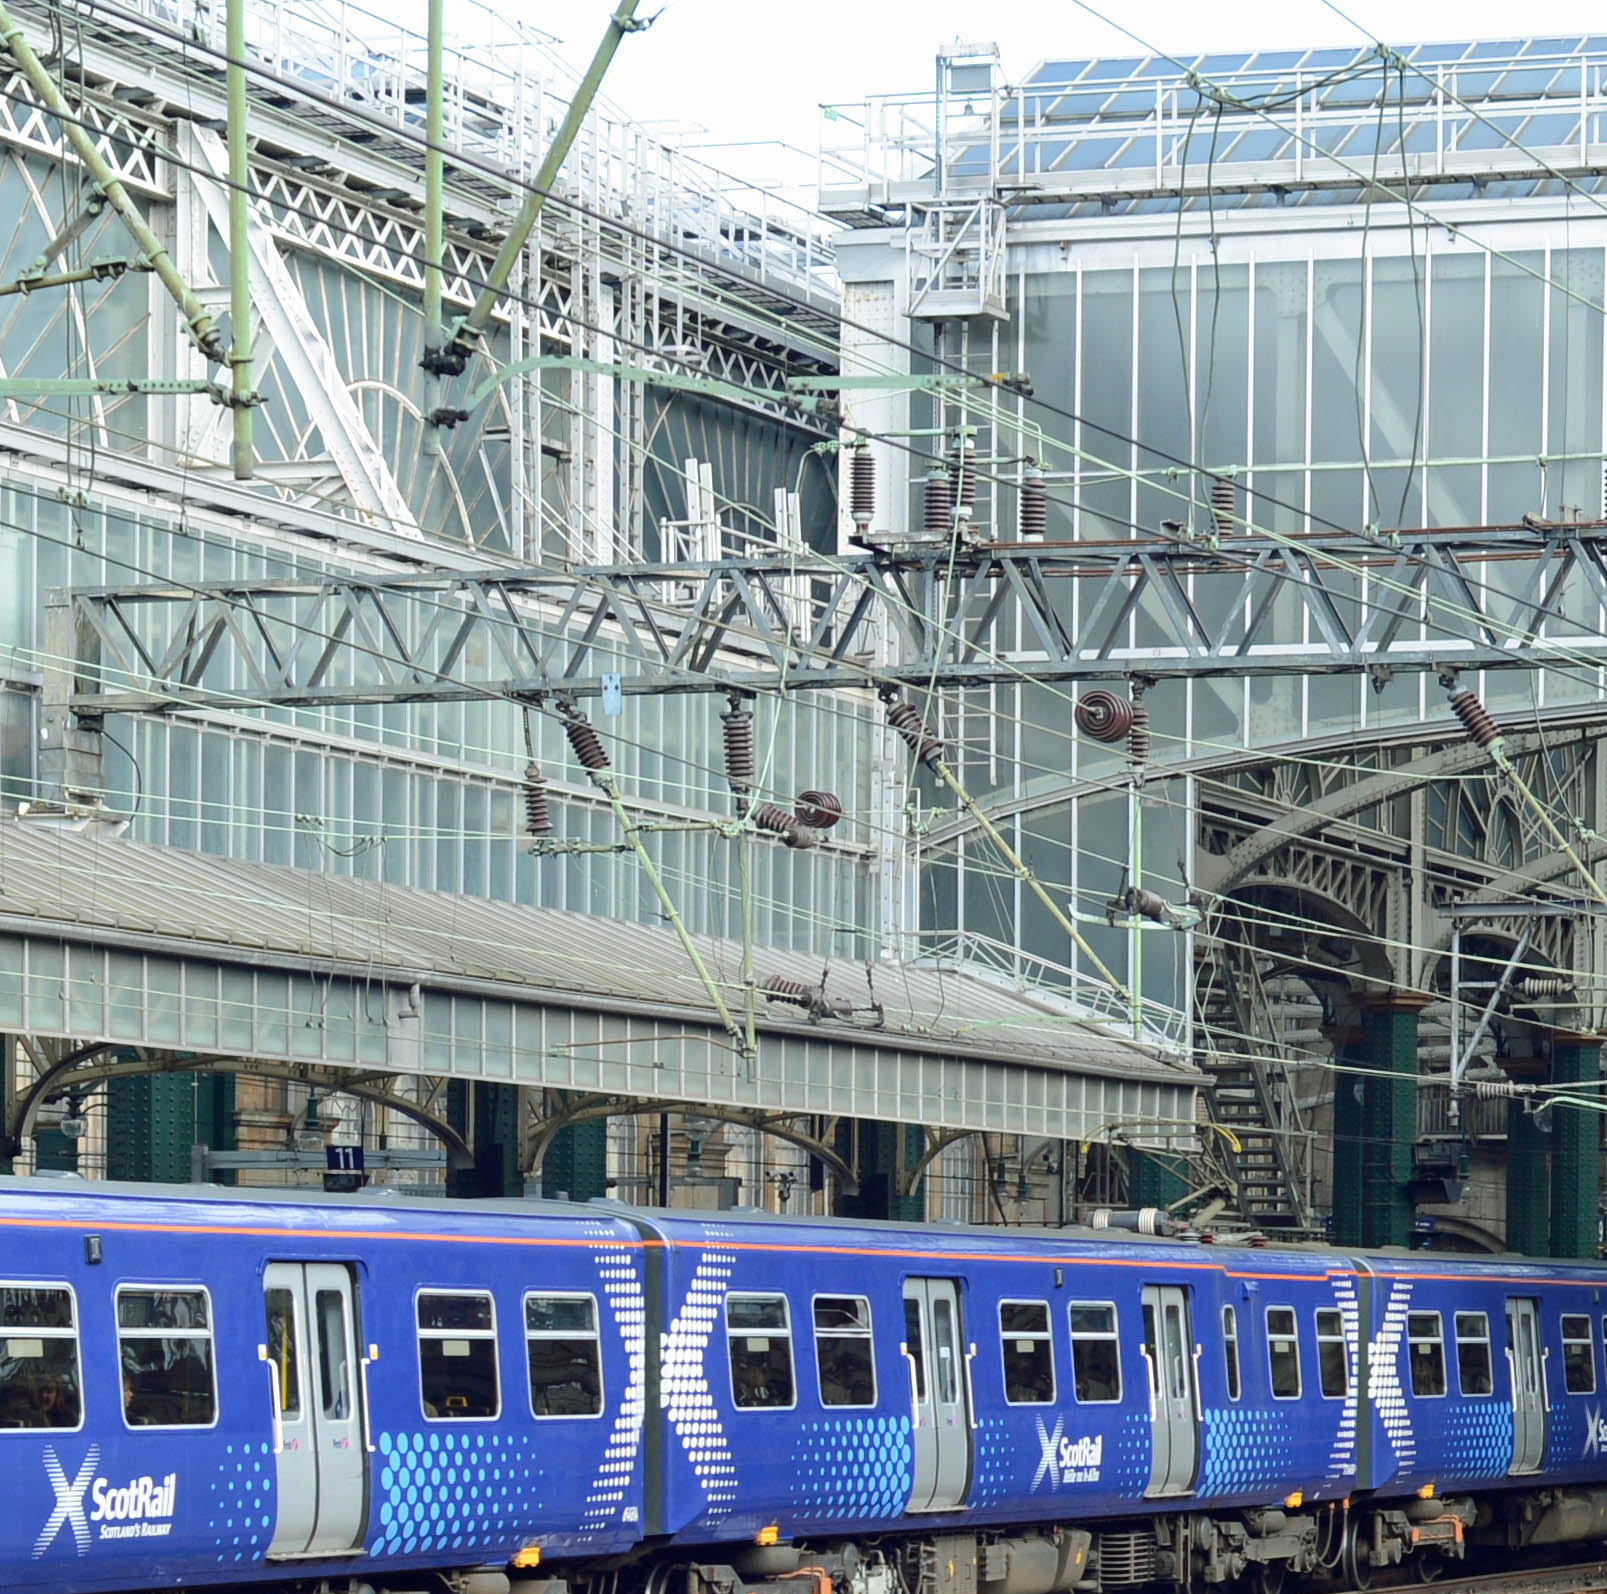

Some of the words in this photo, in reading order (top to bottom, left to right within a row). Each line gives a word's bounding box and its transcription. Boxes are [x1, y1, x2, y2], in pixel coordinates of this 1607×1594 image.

[335, 1147, 354, 1169] 11
[1059, 1434, 1103, 1468] ScotRail
[90, 1472, 176, 1521] ScotRail
